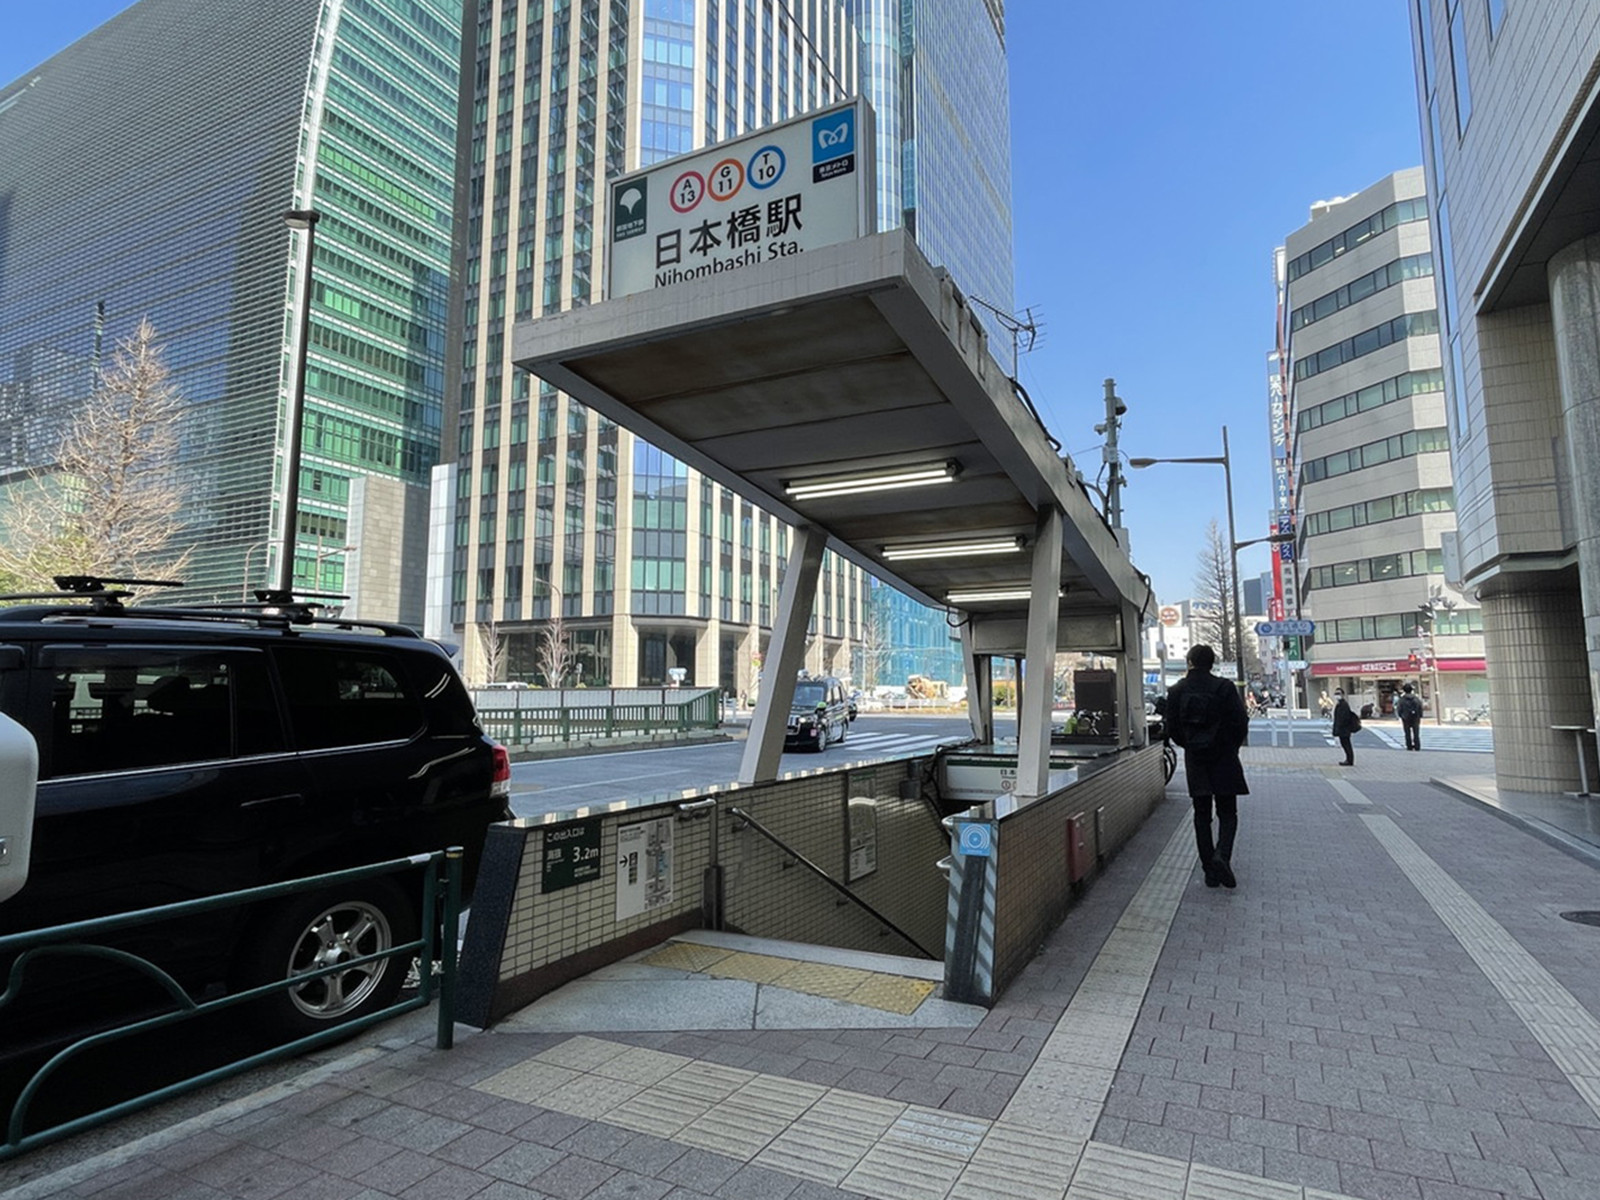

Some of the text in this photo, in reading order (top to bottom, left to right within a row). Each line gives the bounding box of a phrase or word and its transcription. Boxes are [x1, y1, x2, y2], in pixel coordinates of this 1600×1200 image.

[762, 153, 770, 165] T
[720, 166, 731, 178] G
[758, 165, 776, 181] 10
[683, 179, 692, 191] A
[718, 178, 733, 193] 11
[680, 190, 696, 205] 13
[655, 193, 804, 269] 日本橋駅
[655, 241, 803, 288] Nihombashi Sta.
[573, 846, 599, 863] 3.2m
